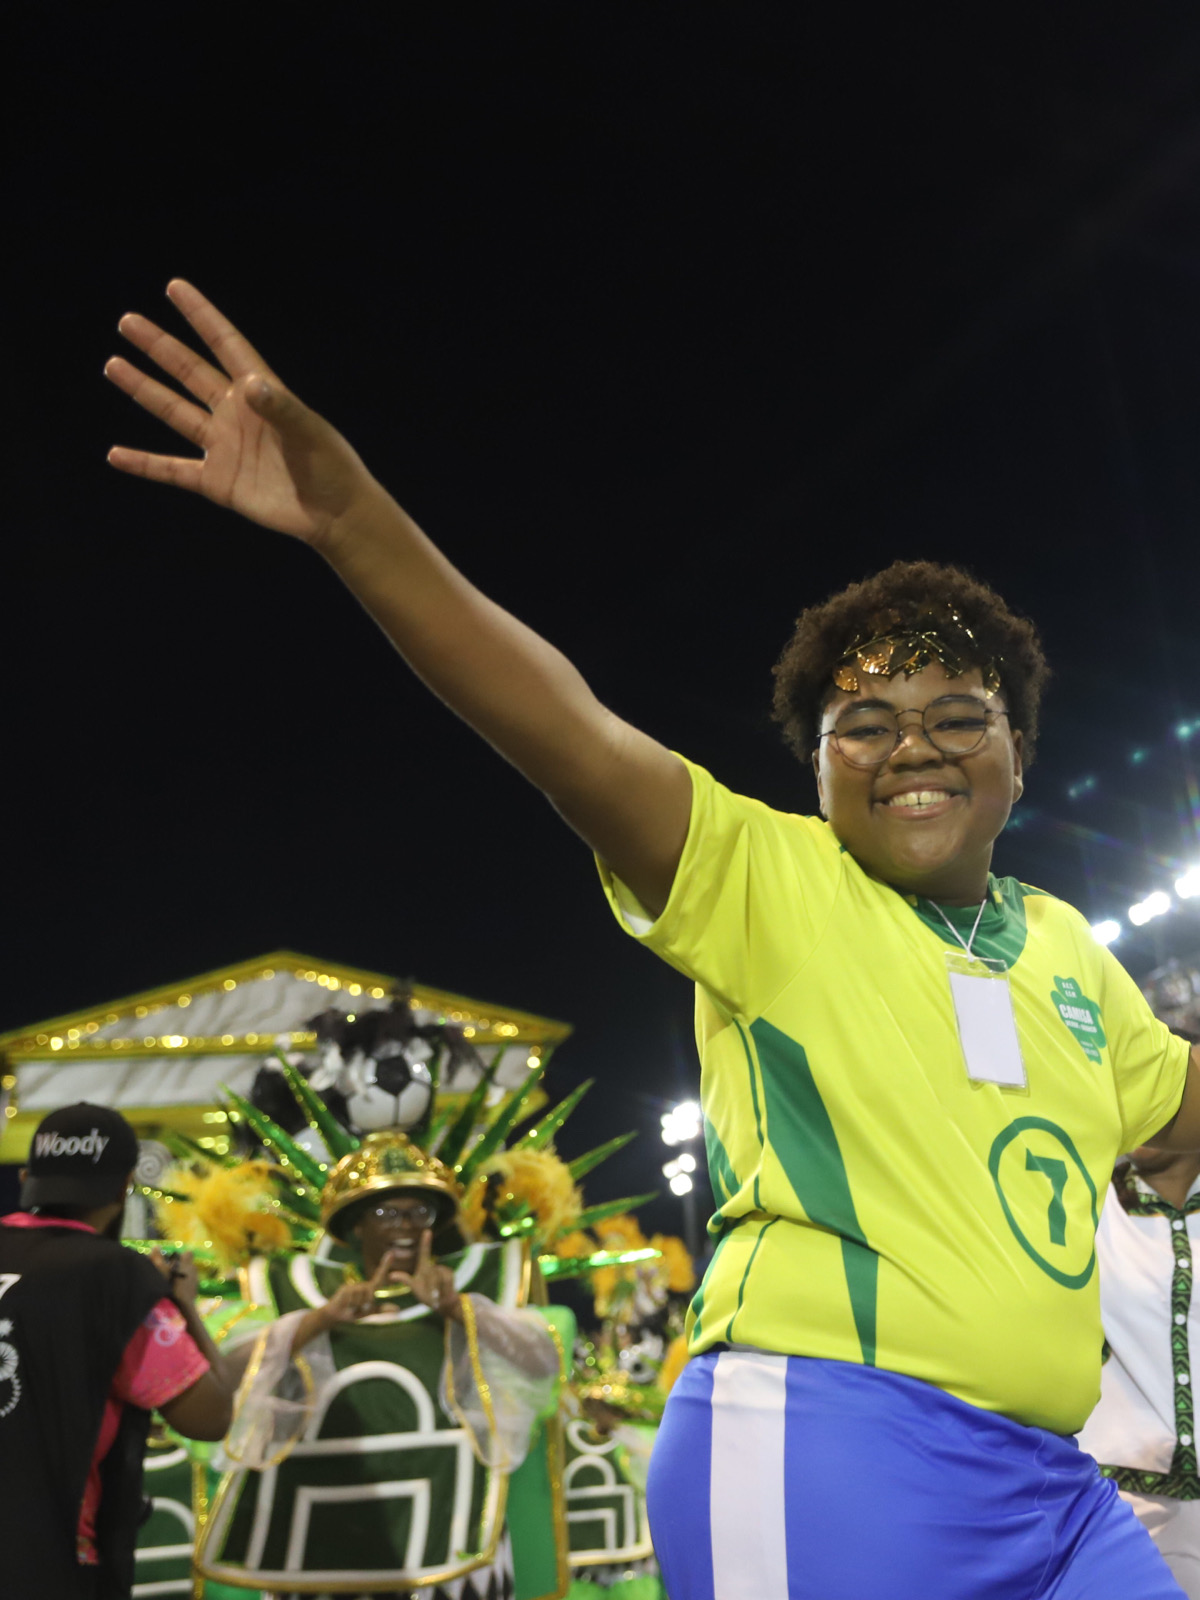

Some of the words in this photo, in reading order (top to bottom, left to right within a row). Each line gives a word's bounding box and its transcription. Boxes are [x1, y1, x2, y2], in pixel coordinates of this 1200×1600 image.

[1059, 1003, 1093, 1025] CAMISA
[35, 1127, 110, 1164] Woody
[1025, 1147, 1069, 1247] 7
